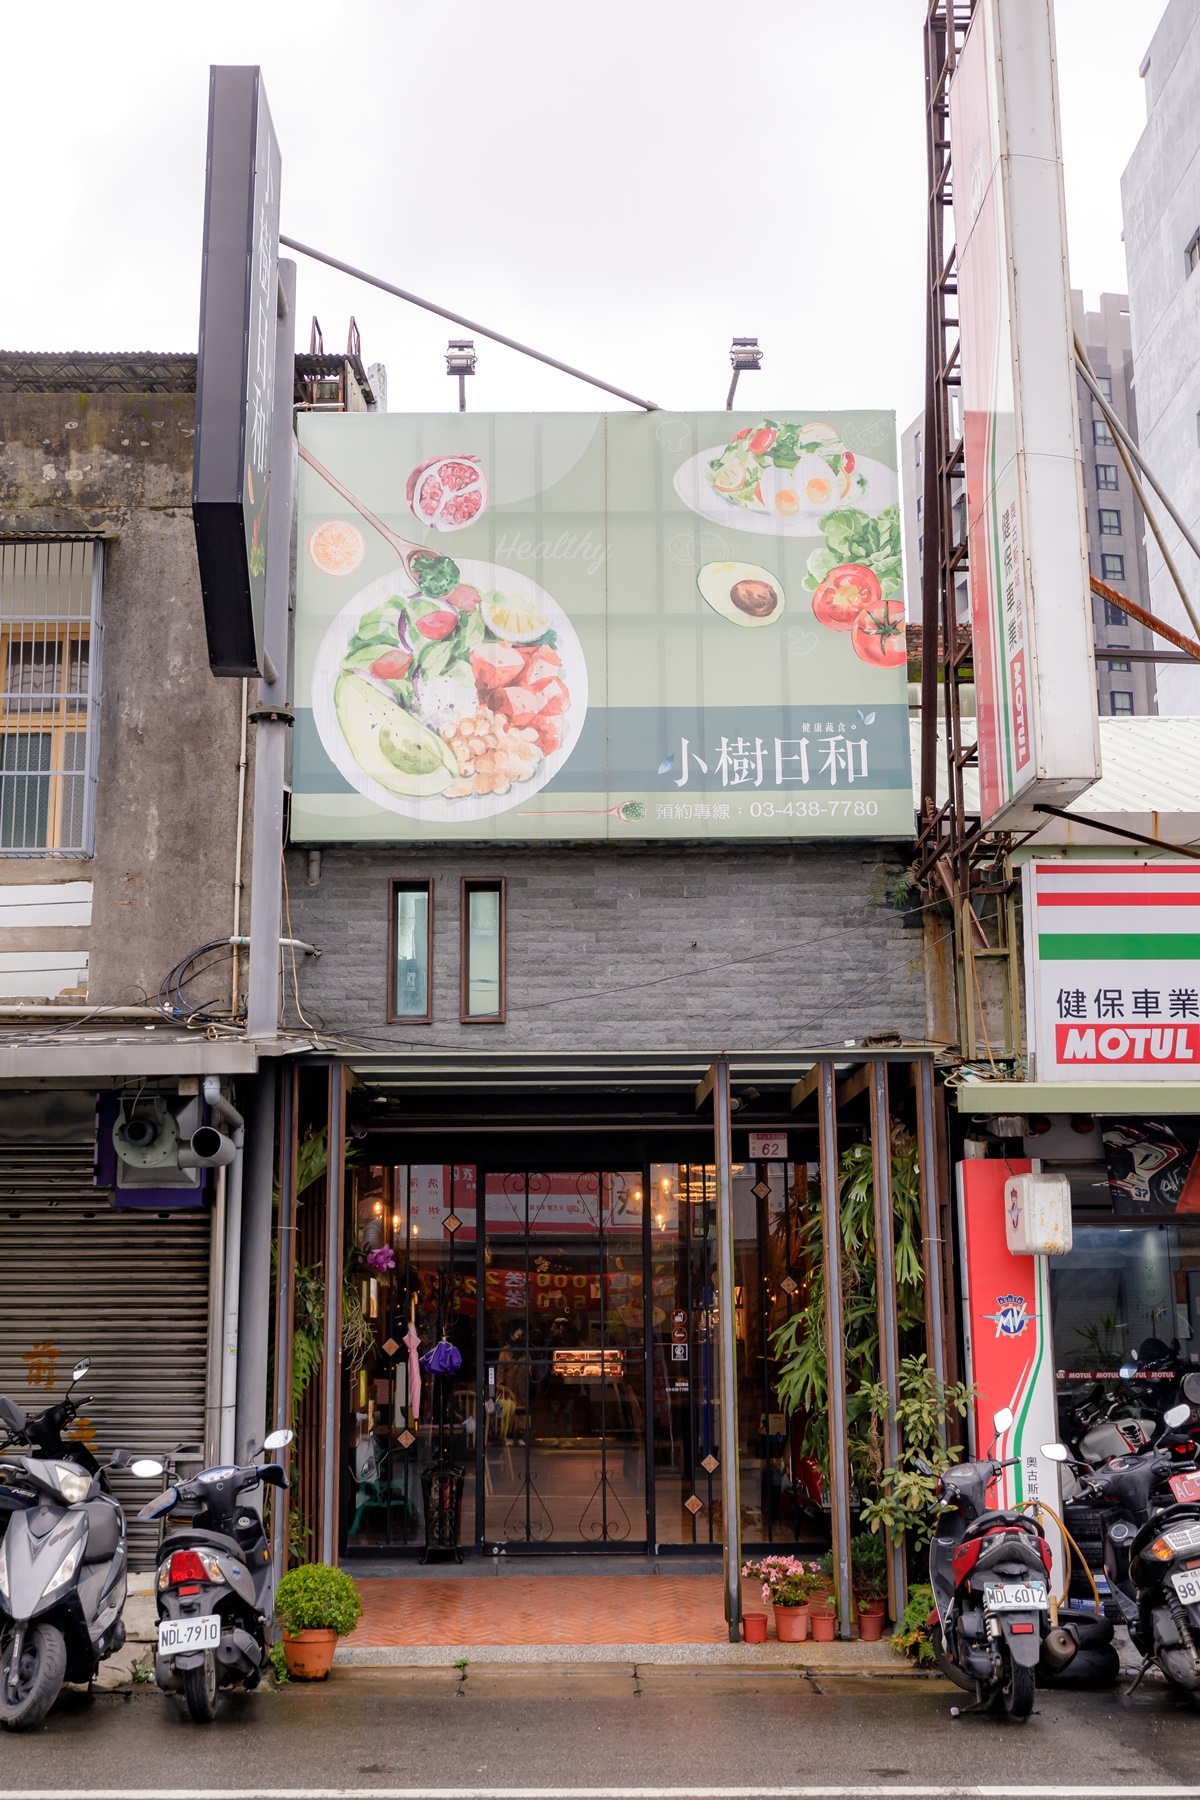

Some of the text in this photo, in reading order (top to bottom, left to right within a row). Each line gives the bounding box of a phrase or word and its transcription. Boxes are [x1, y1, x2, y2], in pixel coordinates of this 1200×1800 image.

[494, 530, 613, 576] Healthy
[1013, 661, 1027, 763] MOTUL
[673, 734, 869, 788] 小樹日和
[749, 800, 878, 818] 03-438-7780
[1056, 987, 1200, 1019] 健保車業
[1062, 1027, 1194, 1060] MOTUL
[762, 1143, 779, 1156] 62
[1134, 1186, 1149, 1198] 37
